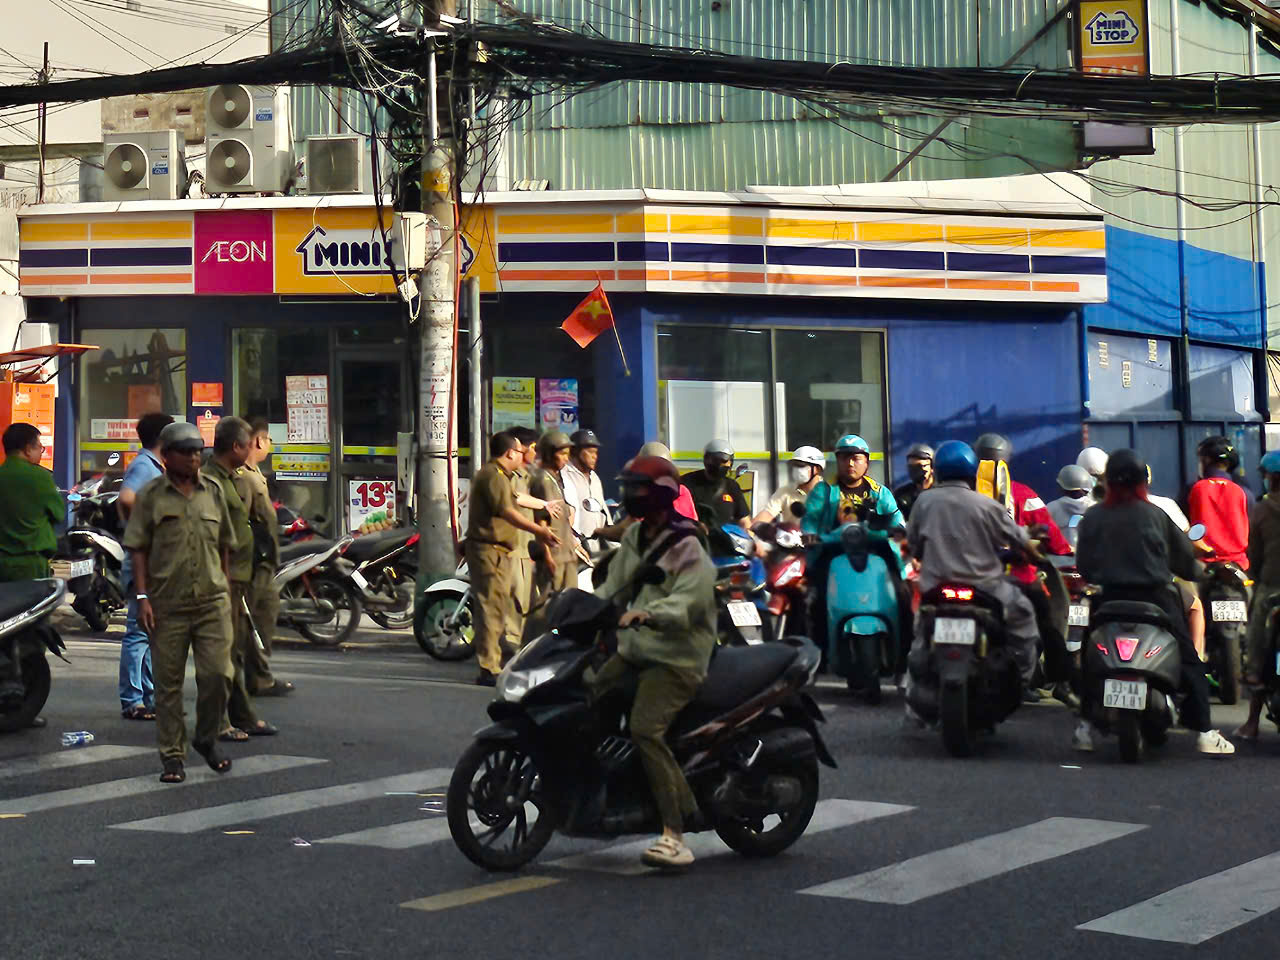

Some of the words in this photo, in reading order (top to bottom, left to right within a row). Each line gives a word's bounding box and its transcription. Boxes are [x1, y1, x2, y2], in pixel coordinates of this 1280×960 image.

[1096, 19, 1126, 29] MINI
[1096, 30, 1129, 40] STOP
[314, 241, 380, 266] MINI
